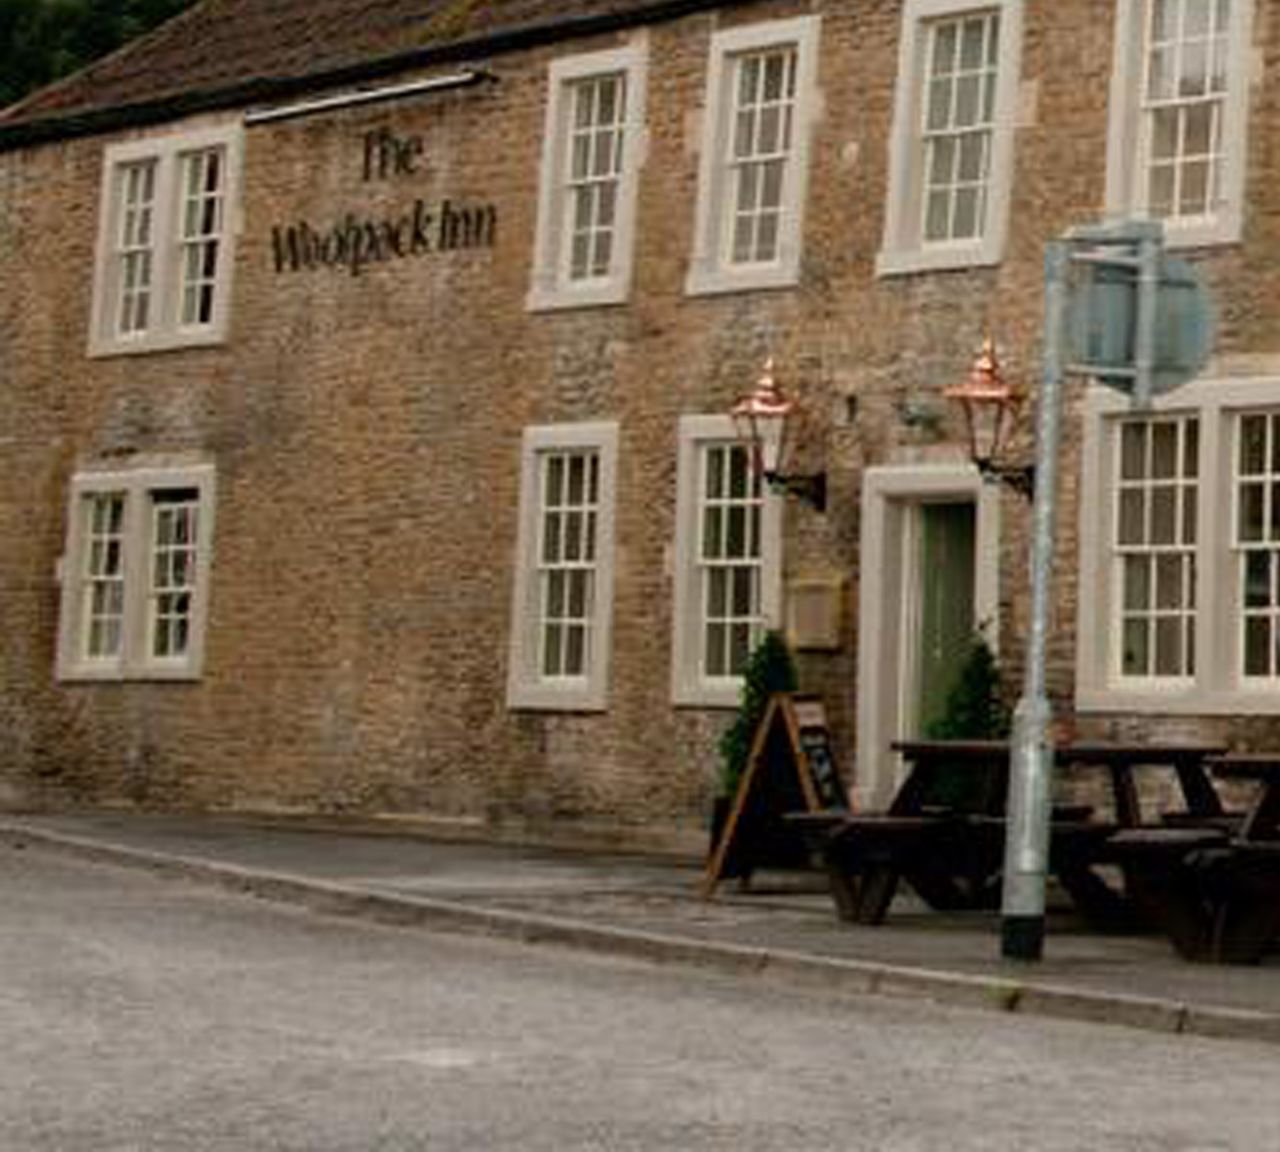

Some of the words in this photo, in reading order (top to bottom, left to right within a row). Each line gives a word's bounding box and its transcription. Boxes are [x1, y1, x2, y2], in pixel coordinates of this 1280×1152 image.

[360, 127, 424, 182] The
[271, 199, 433, 277] Woolpack
[437, 199, 497, 251] Inn
